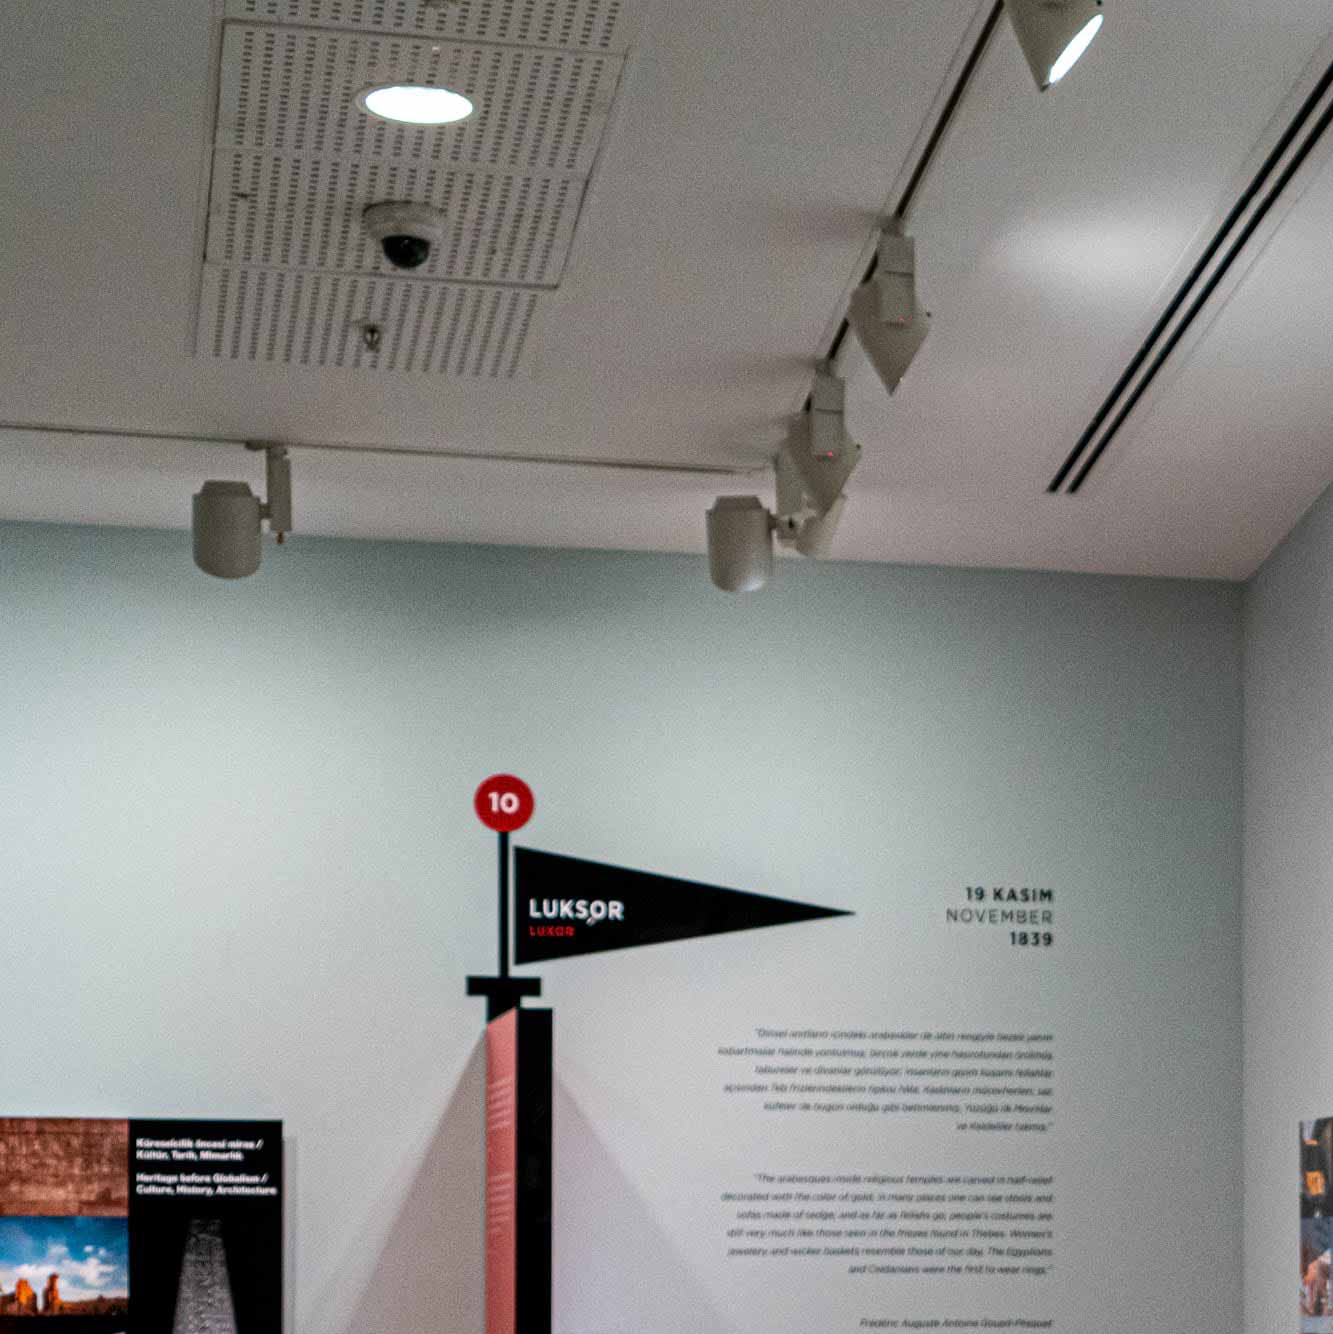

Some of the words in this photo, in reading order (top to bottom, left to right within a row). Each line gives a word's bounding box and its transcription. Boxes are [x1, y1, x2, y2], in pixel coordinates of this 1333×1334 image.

[488, 791, 520, 815] 10
[966, 886, 985, 902] 19
[993, 887, 1053, 903] KASIM
[528, 897, 625, 922] LUKSOR
[946, 908, 1053, 925] NOVEMBER
[1010, 931, 1054, 947] 1839
